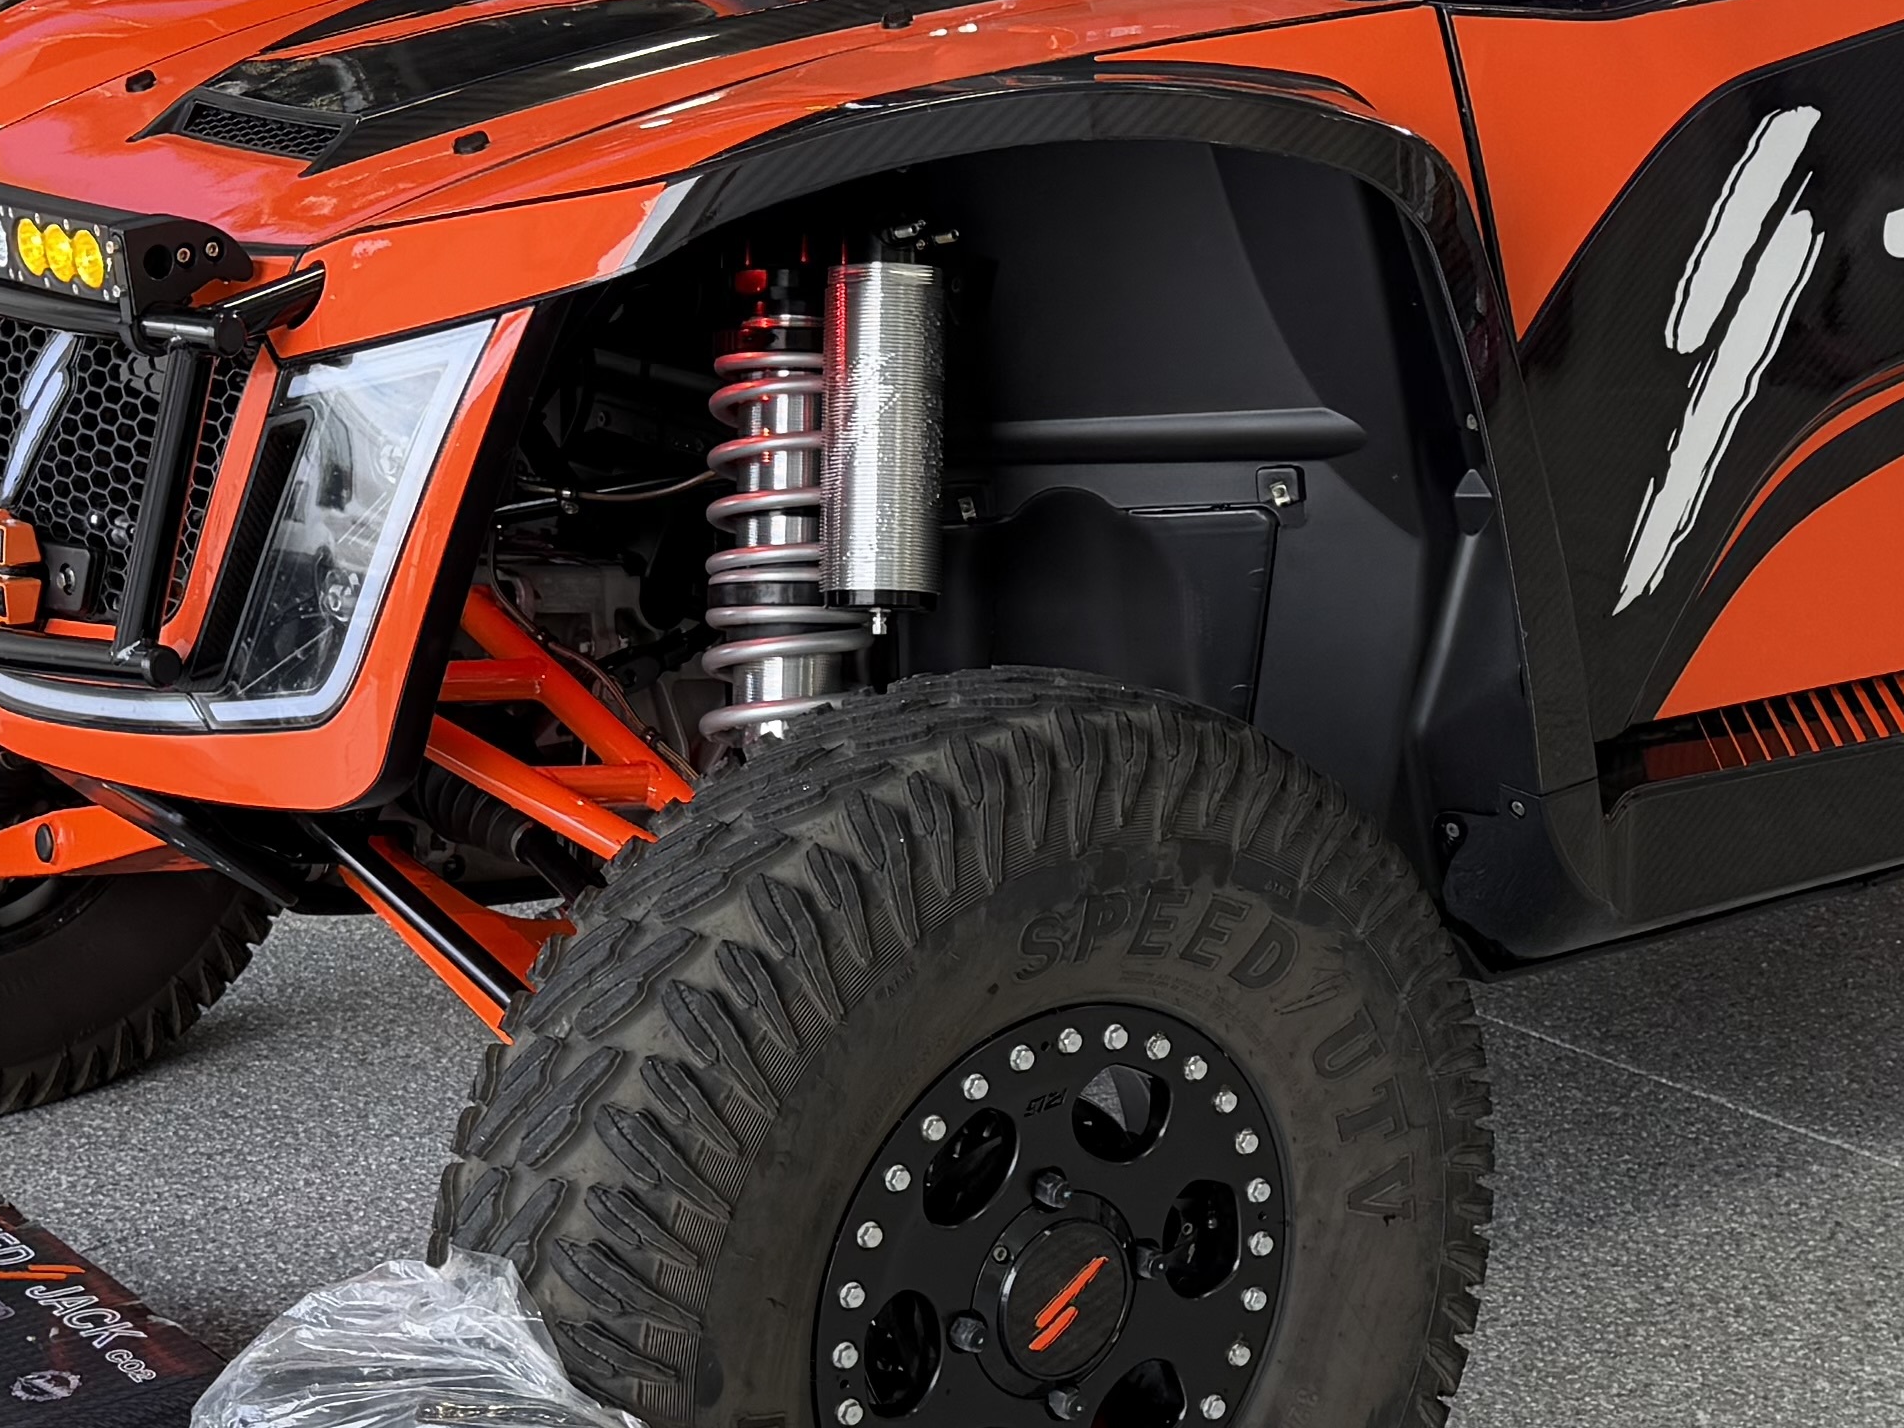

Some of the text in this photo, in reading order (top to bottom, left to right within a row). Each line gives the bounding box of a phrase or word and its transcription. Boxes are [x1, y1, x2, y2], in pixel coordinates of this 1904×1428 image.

[1013, 884, 1415, 1223] SPEED UTV
[25, 1285, 148, 1349] JACK
